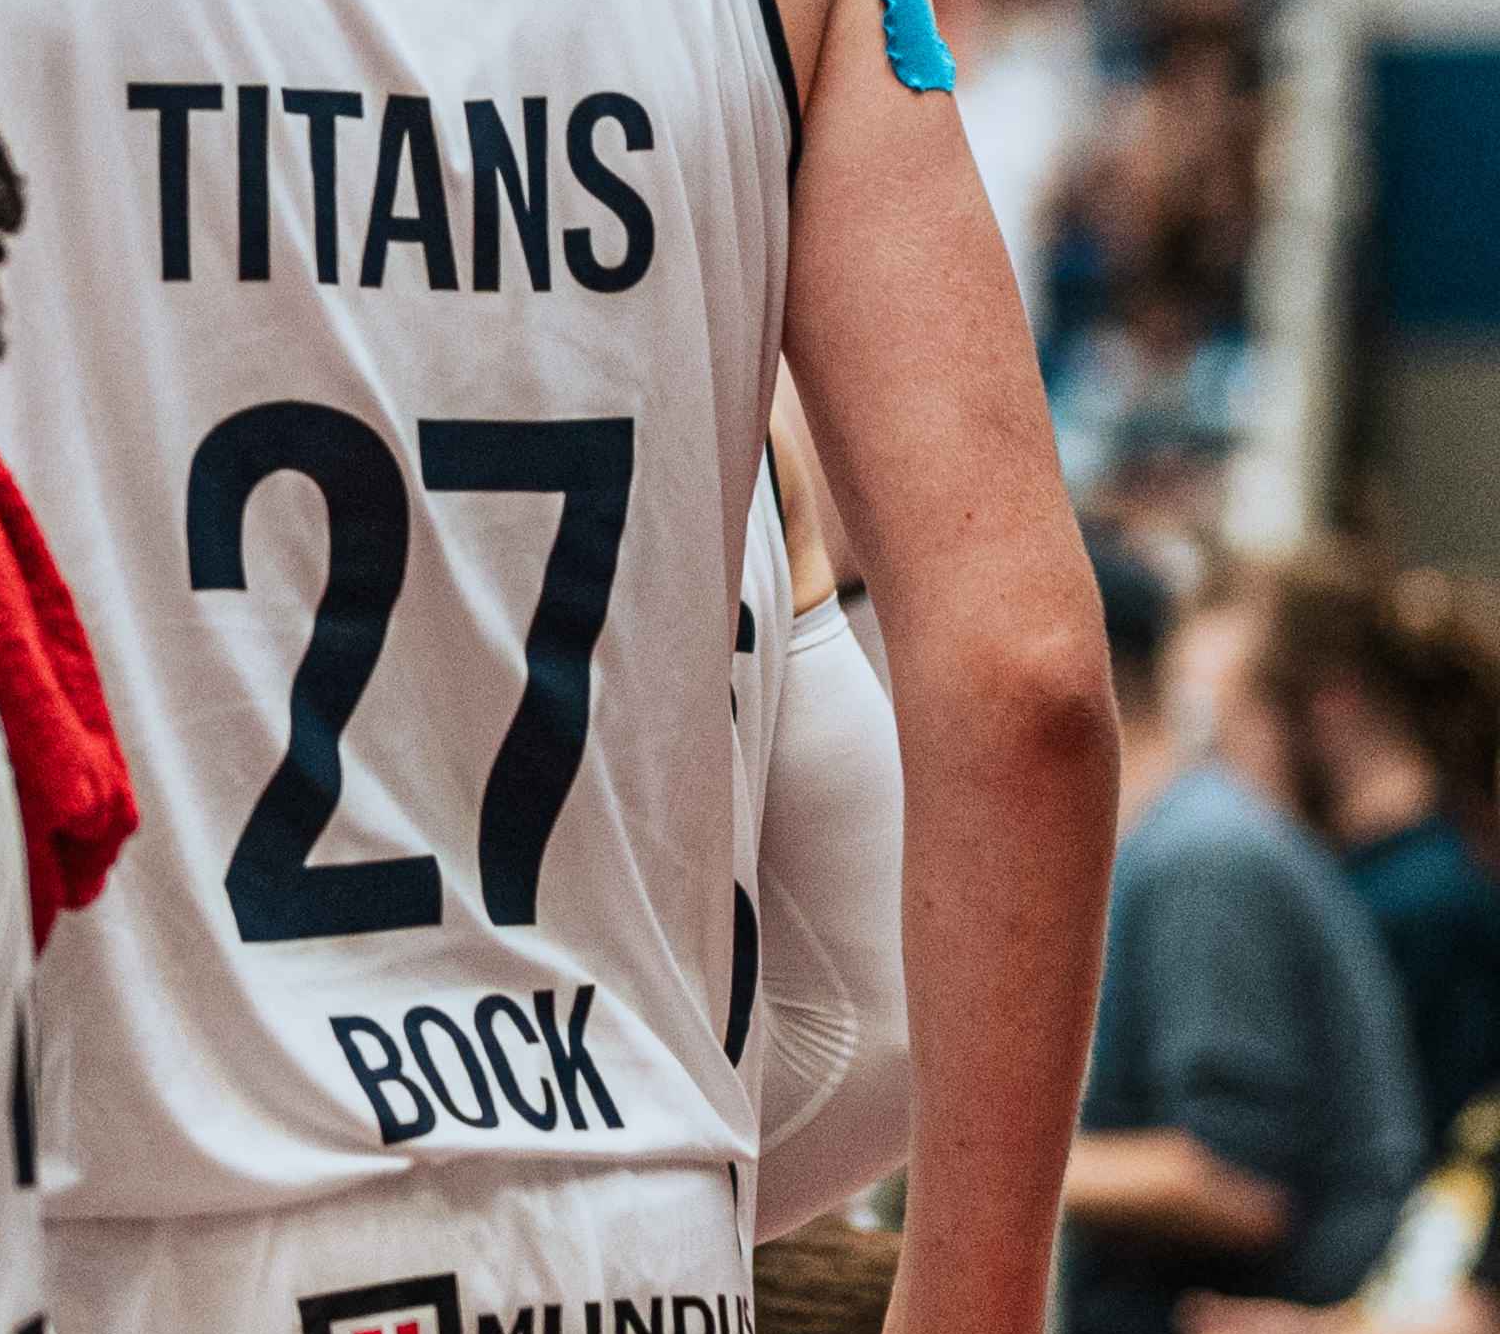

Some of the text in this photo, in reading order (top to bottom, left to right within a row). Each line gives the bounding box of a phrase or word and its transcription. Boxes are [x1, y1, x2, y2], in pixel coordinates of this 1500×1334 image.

[126, 81, 656, 294] TITANS
[186, 399, 635, 944] 27
[328, 984, 625, 1146] BOCK
